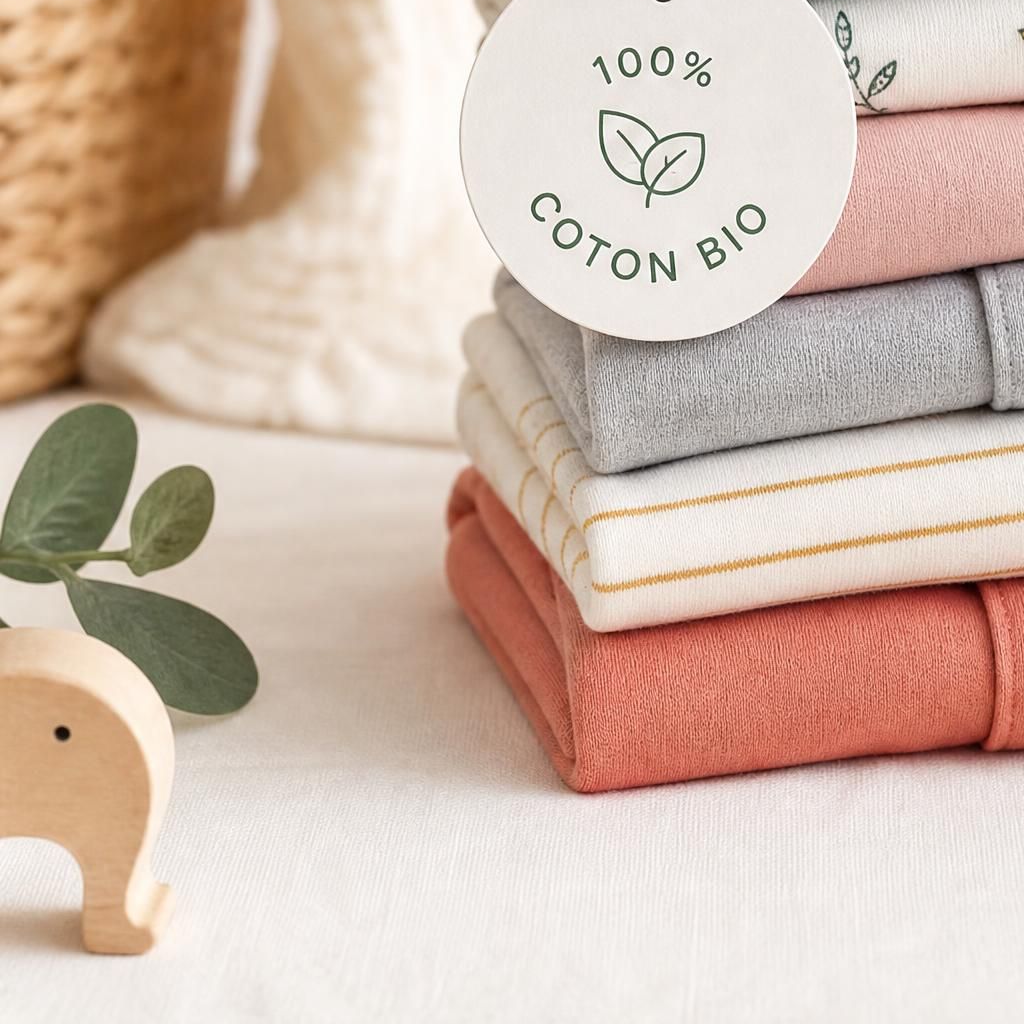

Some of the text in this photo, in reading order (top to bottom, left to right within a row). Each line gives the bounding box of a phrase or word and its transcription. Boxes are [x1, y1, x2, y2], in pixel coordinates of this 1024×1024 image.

[592, 45, 713, 88] 100%
[530, 192, 767, 284] COTON BIO
